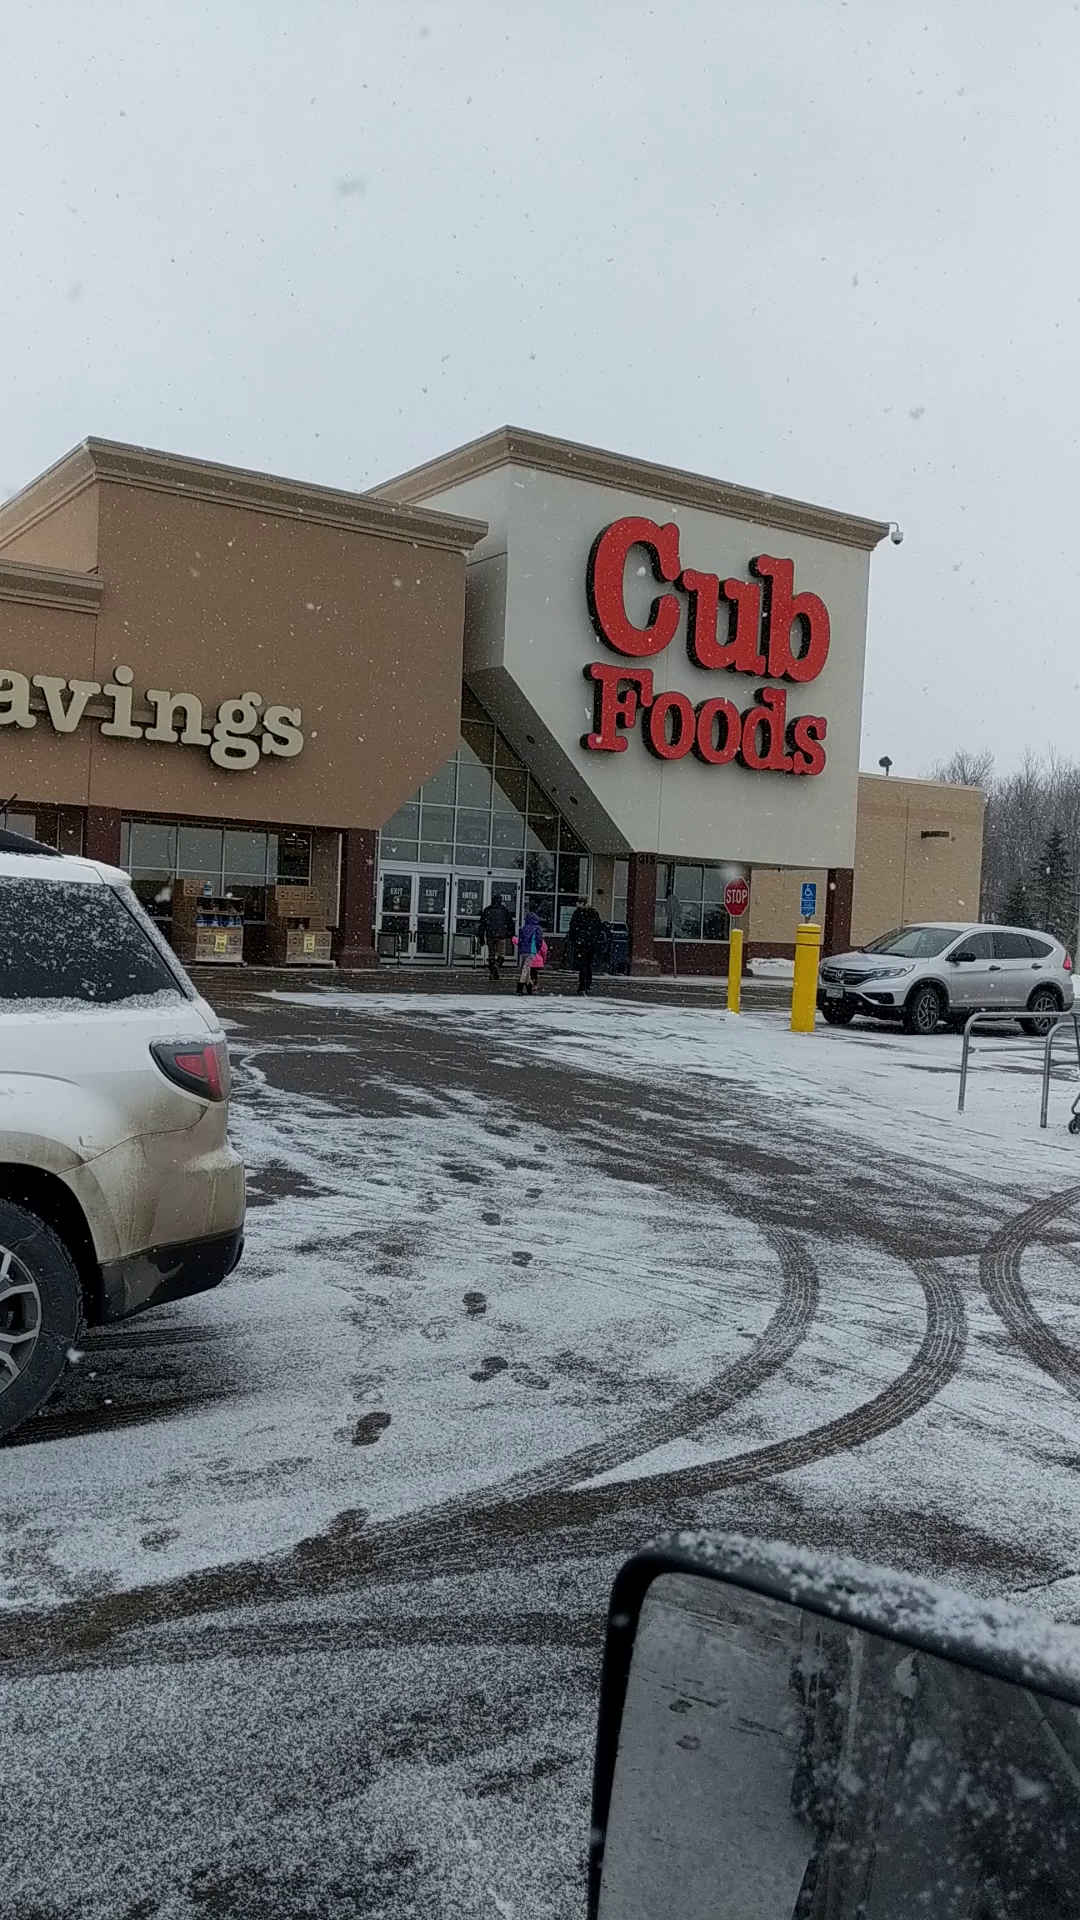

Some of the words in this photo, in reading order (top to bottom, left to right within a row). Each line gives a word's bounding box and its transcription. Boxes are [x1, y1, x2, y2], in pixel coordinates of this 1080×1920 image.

[586, 516, 830, 682] Cub
[580, 662, 828, 775] Foods
[425, 889, 438, 897] EXIT
[725, 889, 748, 904] STOP
